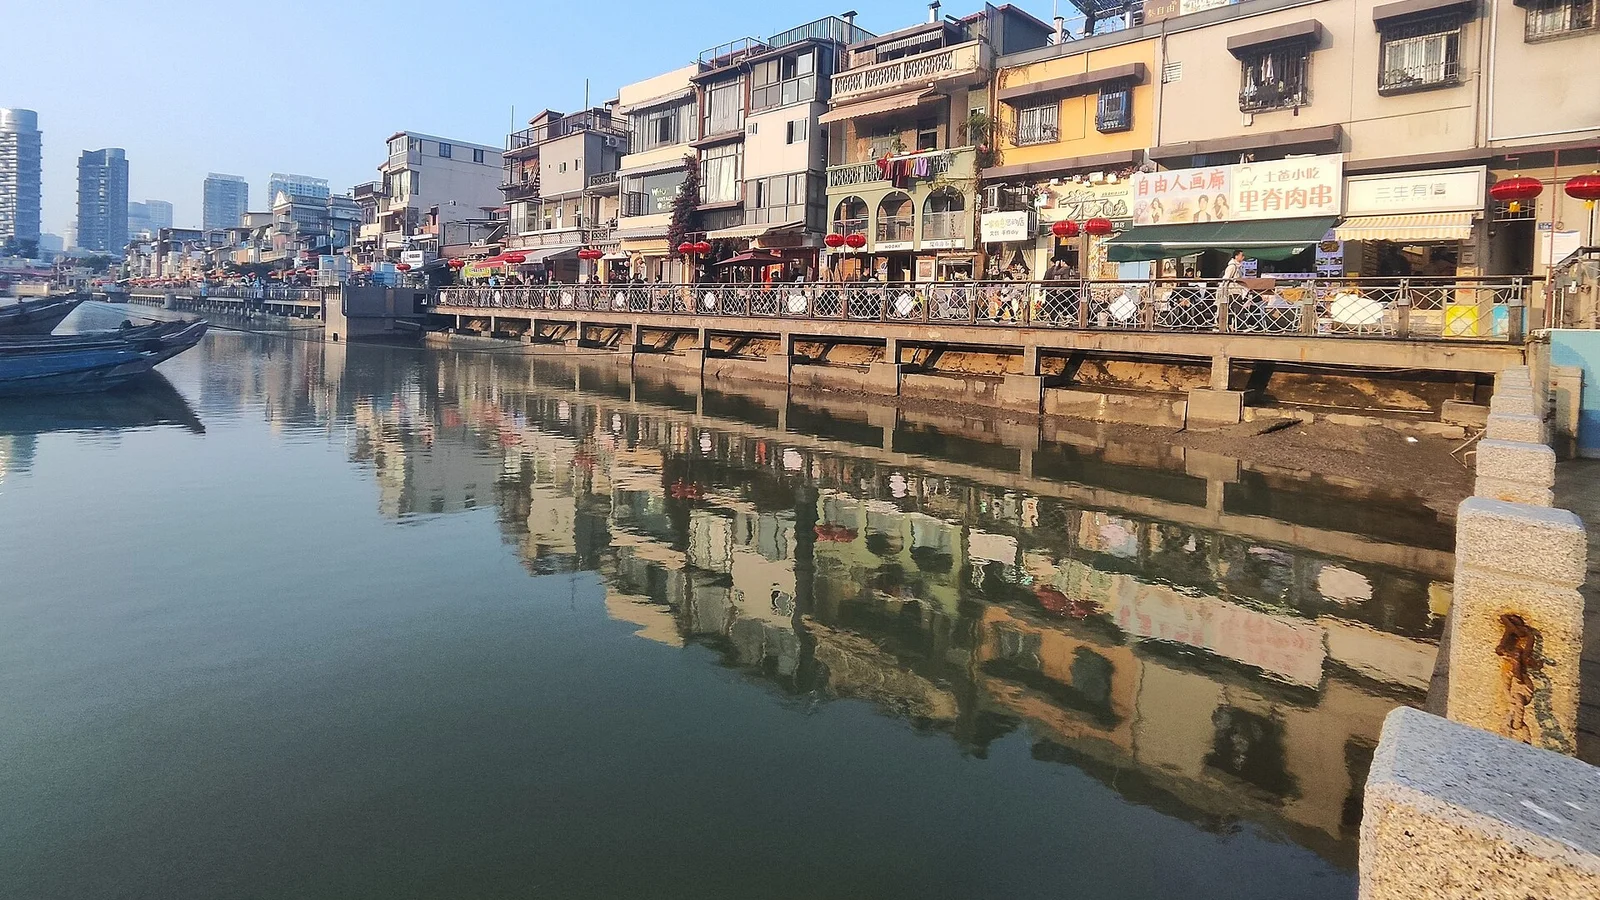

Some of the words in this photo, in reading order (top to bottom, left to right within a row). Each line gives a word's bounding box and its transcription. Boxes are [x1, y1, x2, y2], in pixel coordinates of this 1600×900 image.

[1138, 168, 1225, 196] 自由人画廊
[1376, 183, 1447, 199] 三生有信
[1239, 184, 1332, 212] 里脊肉串
